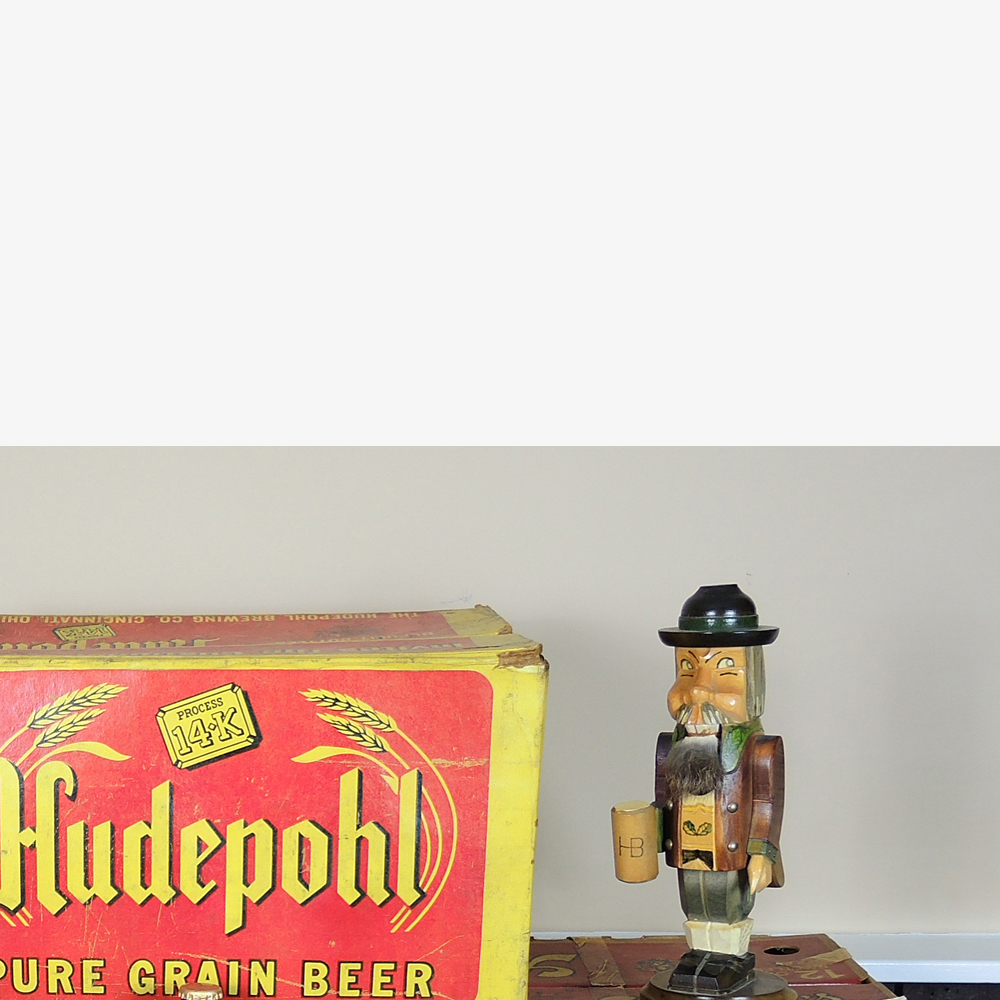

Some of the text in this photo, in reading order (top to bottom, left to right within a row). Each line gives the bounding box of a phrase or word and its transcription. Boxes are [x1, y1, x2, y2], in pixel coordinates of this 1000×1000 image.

[192, 614, 284, 624] BREWING
[288, 613, 378, 622] HUDEPOHL
[175, 696, 226, 722] PROCESS
[128, 958, 279, 999] GRAIN
[301, 958, 437, 999] BEER
